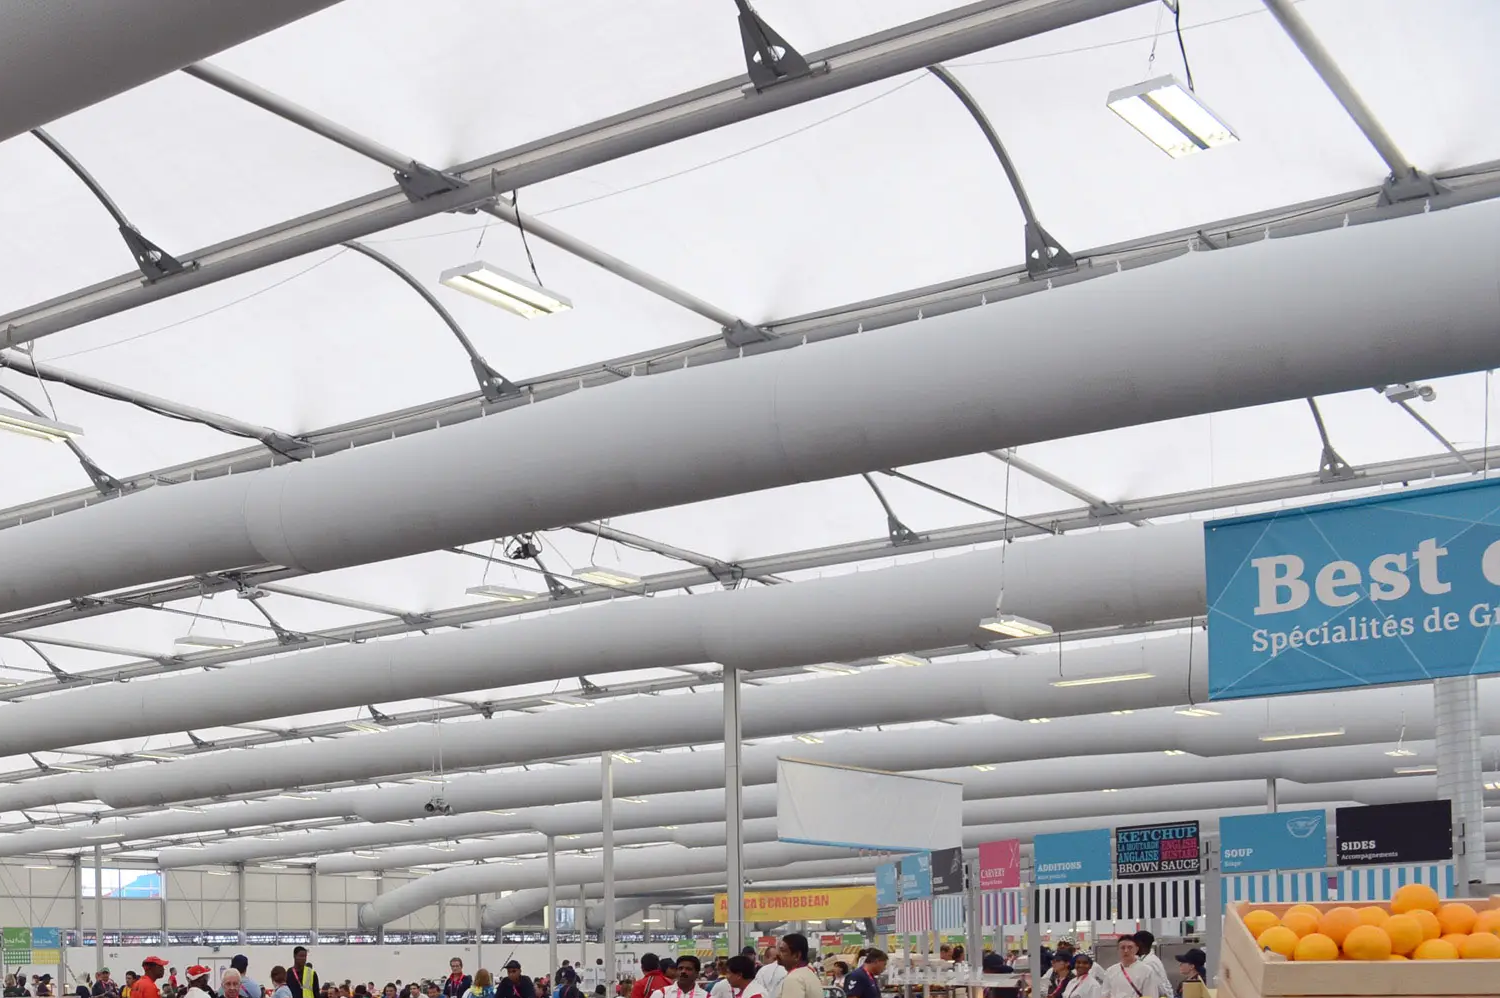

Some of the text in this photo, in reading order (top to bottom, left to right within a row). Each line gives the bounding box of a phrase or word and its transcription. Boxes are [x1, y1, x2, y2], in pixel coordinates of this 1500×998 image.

[1251, 538, 1452, 616] Best
[1252, 614, 1415, 658] Spécialités
[1423, 606, 1461, 634] de
[1118, 827, 1197, 844] KETCHUP
[1341, 840, 1376, 851] SIDES
[1118, 850, 1159, 863] ANGLAISE
[1224, 848, 1253, 859] SOUP
[1037, 861, 1082, 873] ADDITIONS
[1119, 859, 1199, 874] BROWN SAUCE
[767, 895, 830, 909] CARIBBEAN
